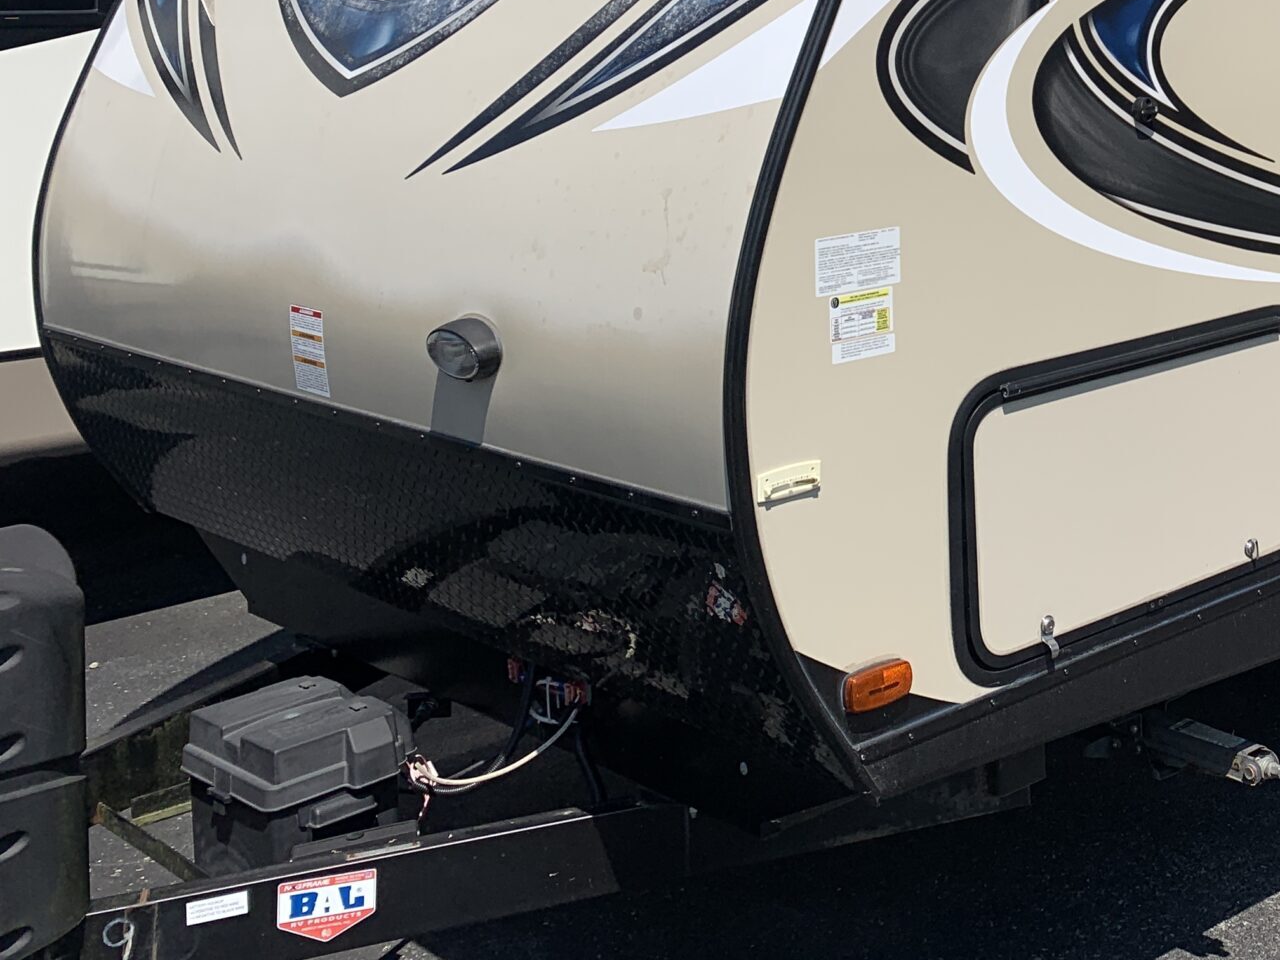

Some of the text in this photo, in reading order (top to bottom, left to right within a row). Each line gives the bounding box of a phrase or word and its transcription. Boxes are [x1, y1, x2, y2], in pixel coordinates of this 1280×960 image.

[289, 885, 365, 919] BAL
[290, 921, 304, 929] RV
[308, 912, 362, 926] PRODUCTS
